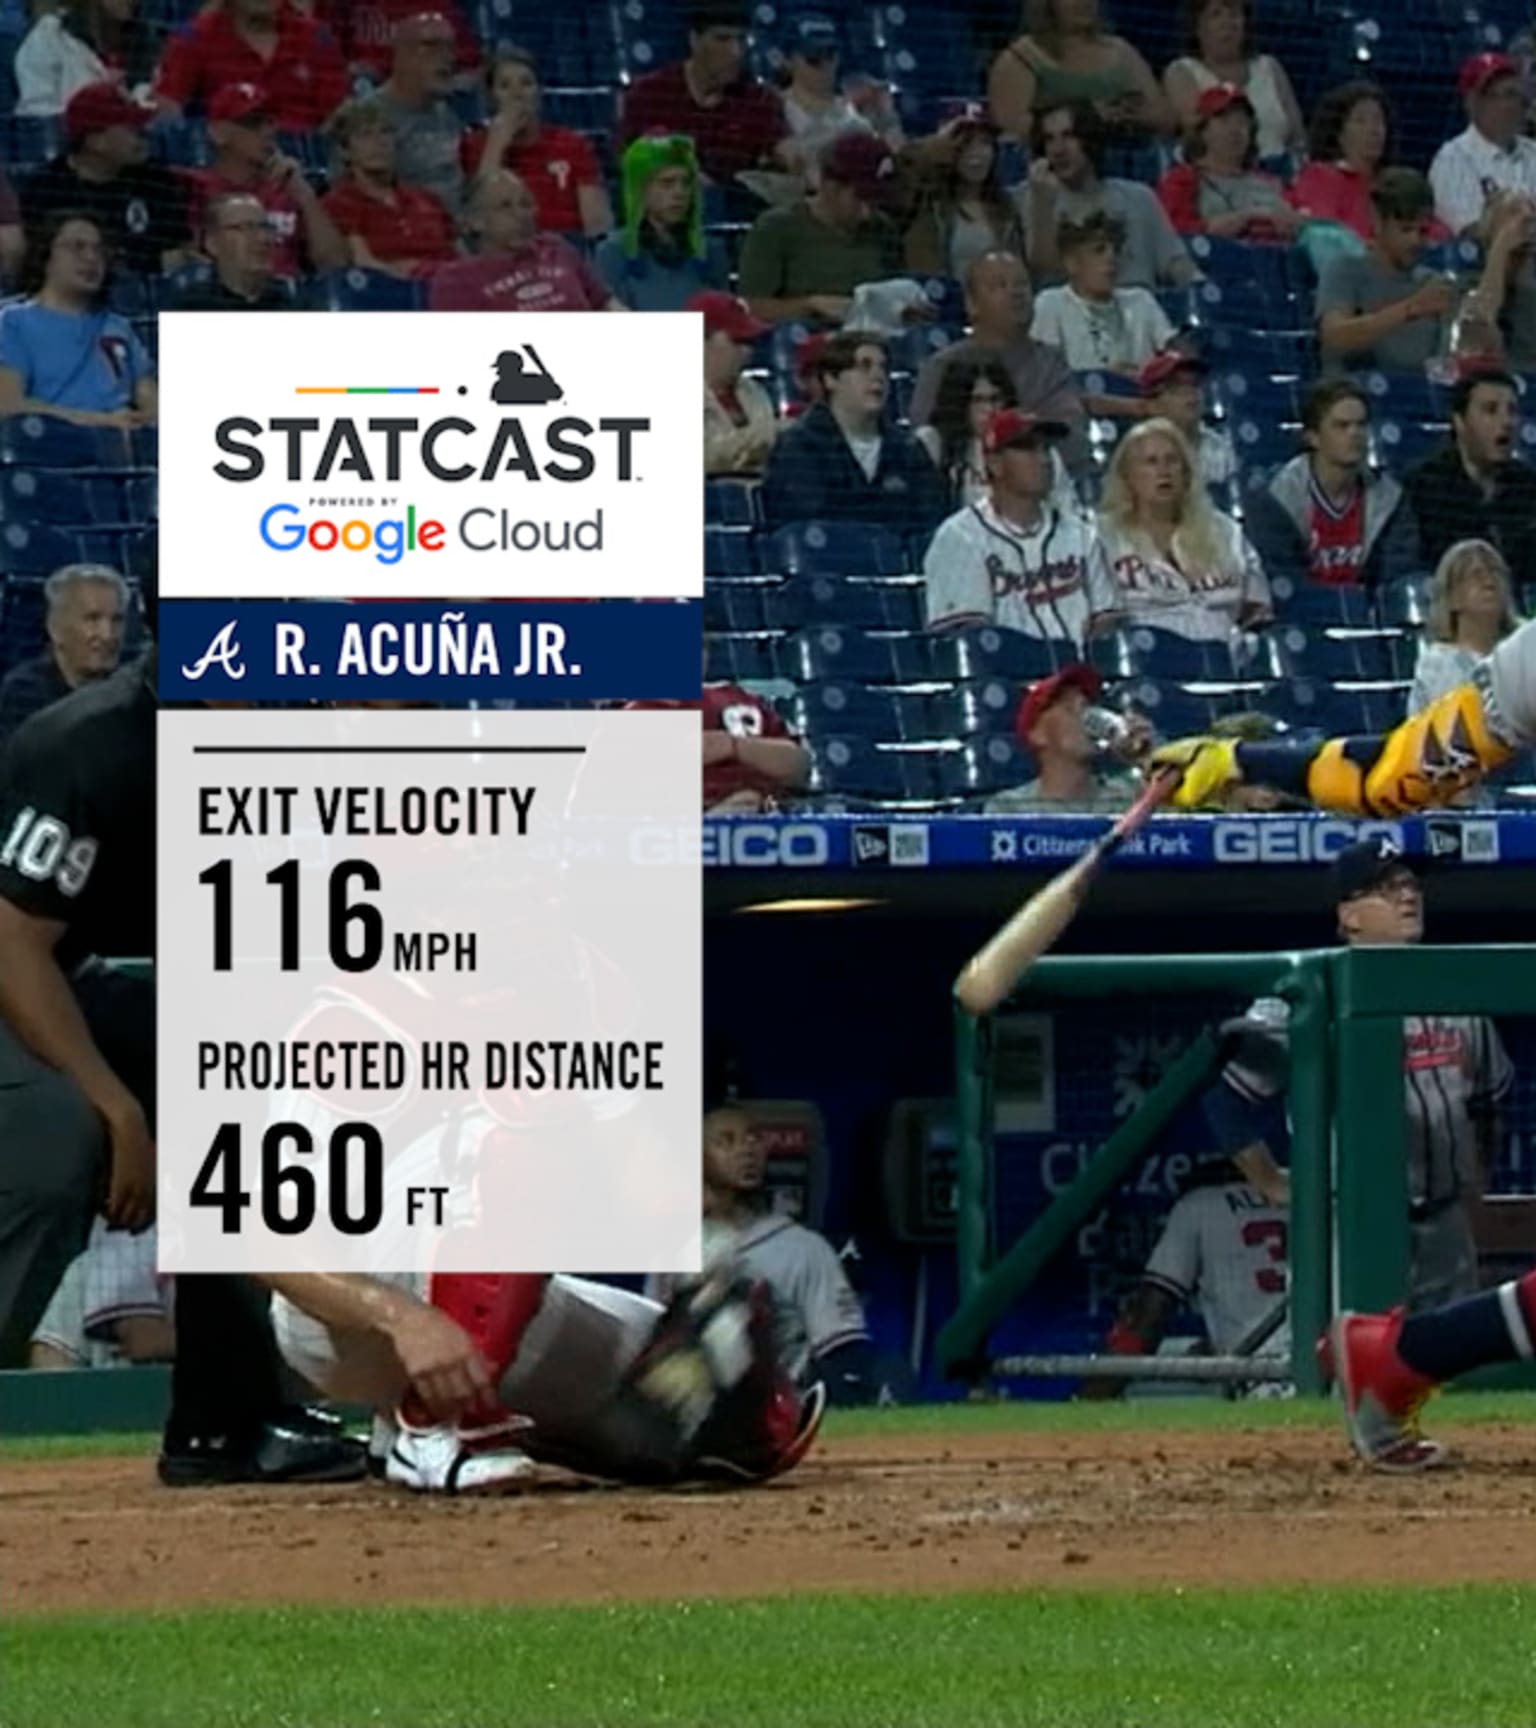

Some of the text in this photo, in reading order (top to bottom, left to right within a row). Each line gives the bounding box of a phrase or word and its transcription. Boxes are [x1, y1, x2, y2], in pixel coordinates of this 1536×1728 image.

[0, 804, 98, 897] 109
[1022, 833, 1093, 857] Citizen
[1149, 832, 1192, 856] Park
[1213, 820, 1402, 864] GEICO
